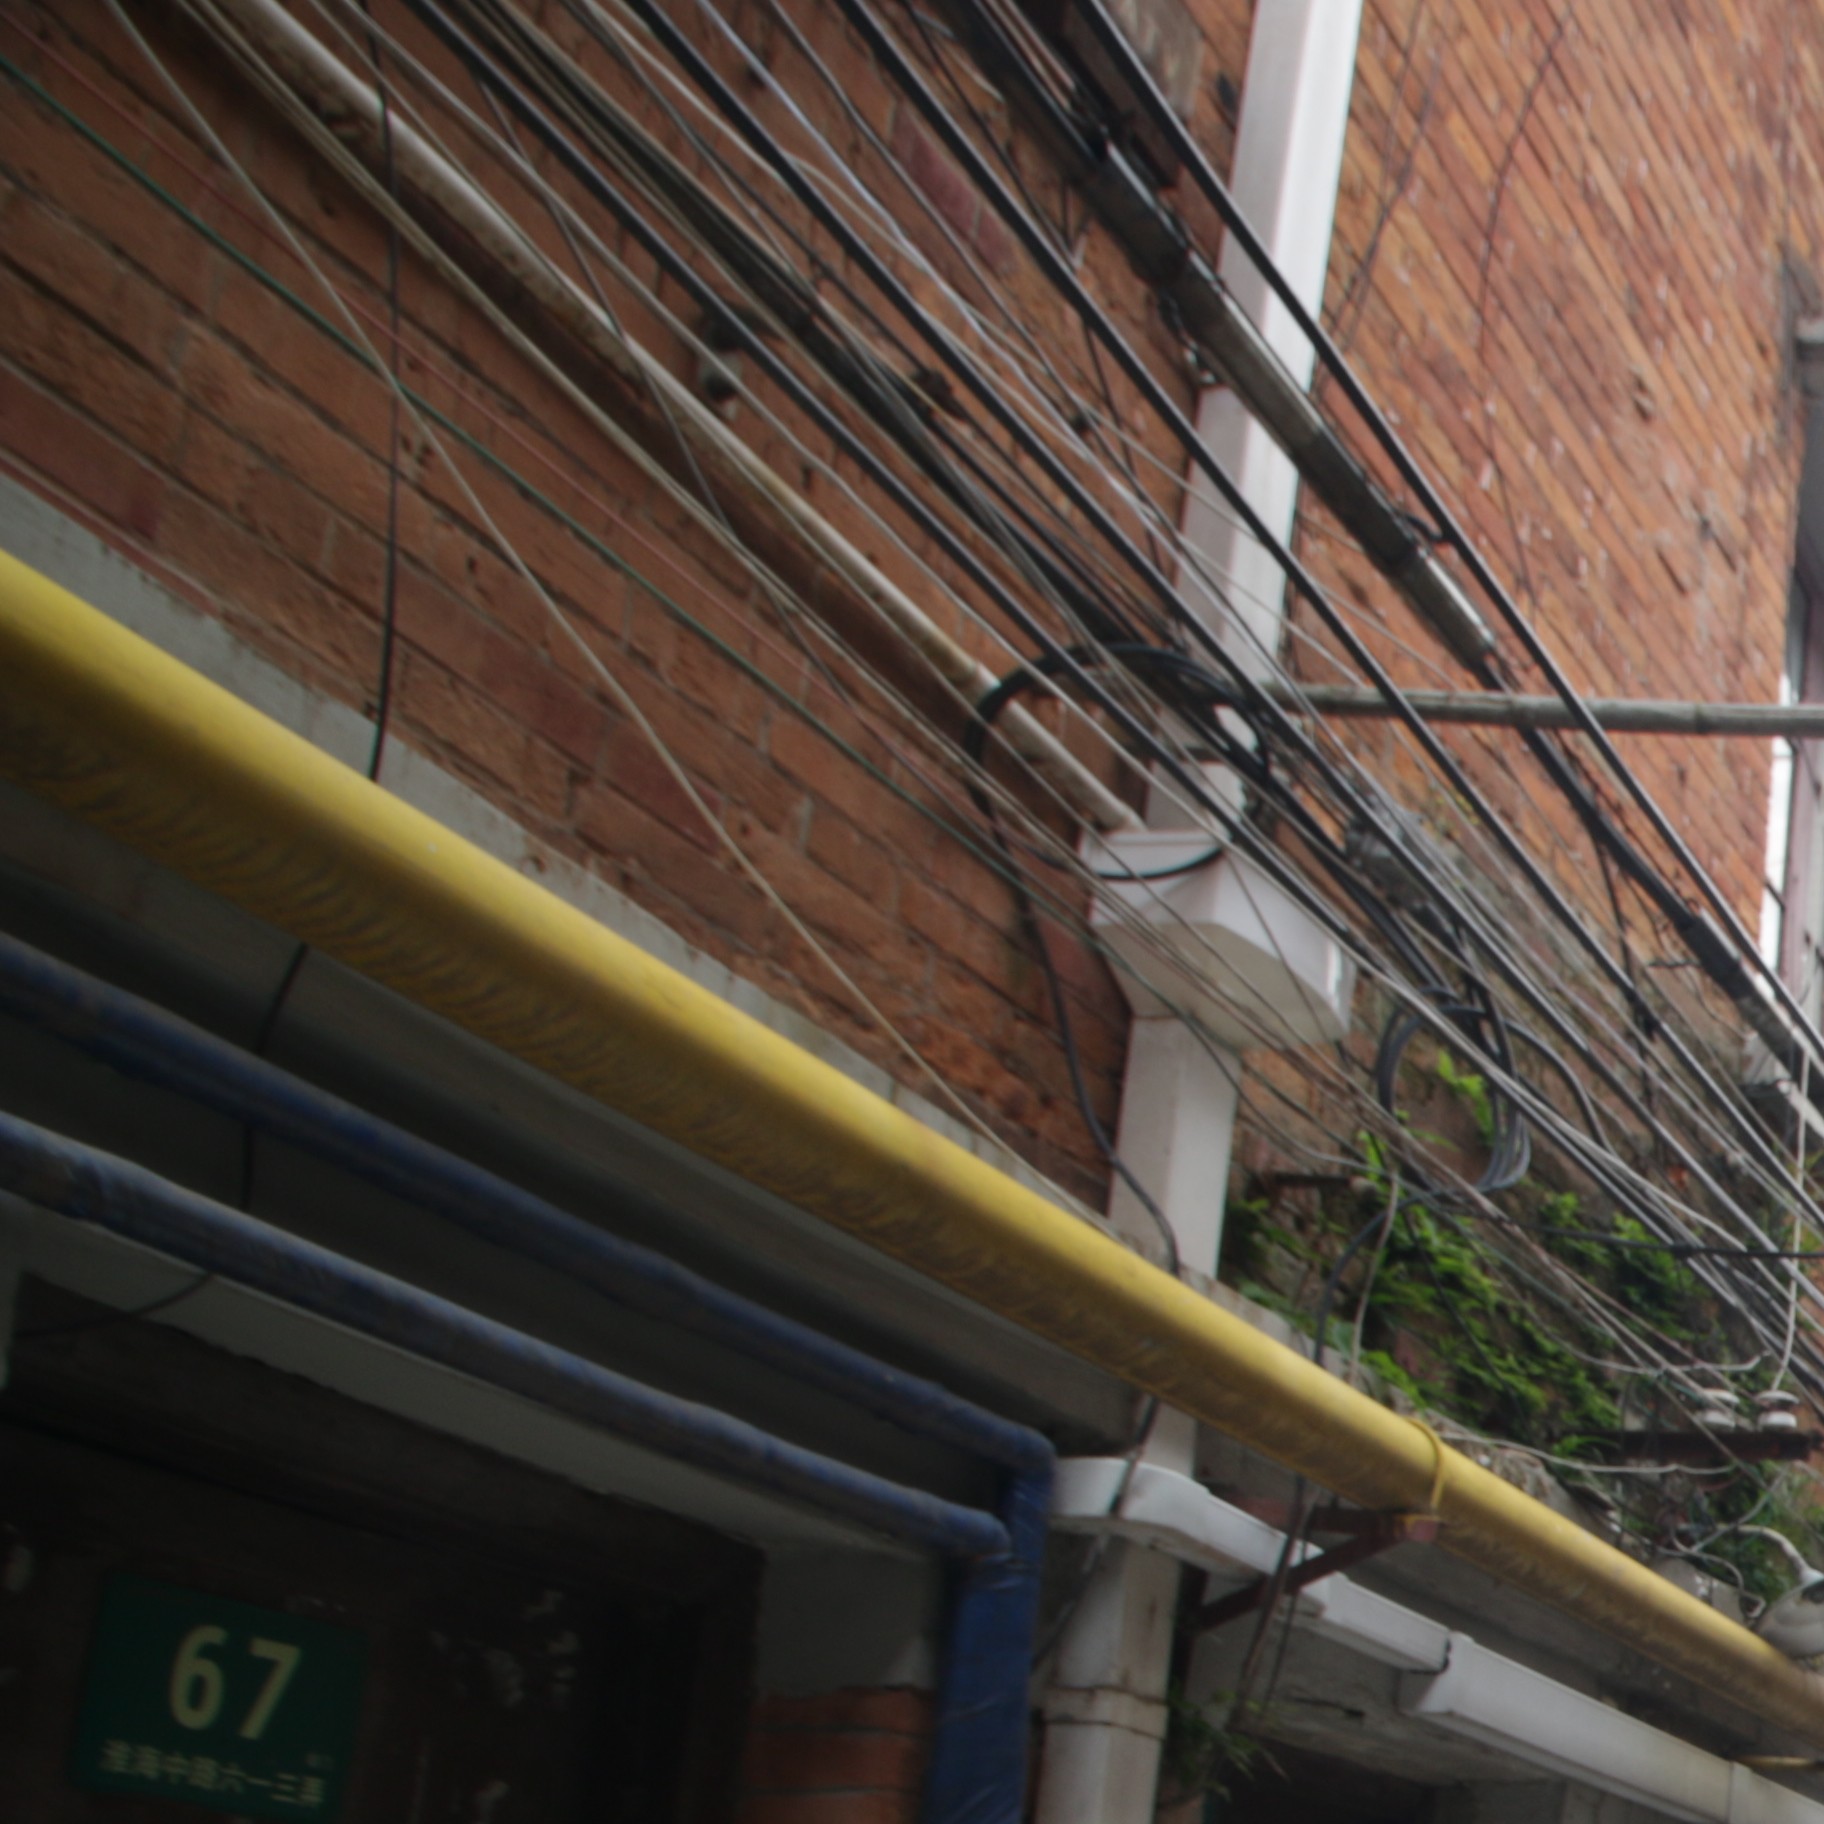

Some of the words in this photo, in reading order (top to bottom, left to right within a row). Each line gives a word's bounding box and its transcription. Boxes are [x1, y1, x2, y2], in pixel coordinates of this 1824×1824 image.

[169, 1624, 303, 1740] 67
[100, 1738, 325, 1807] 淮海中路六一三弄
